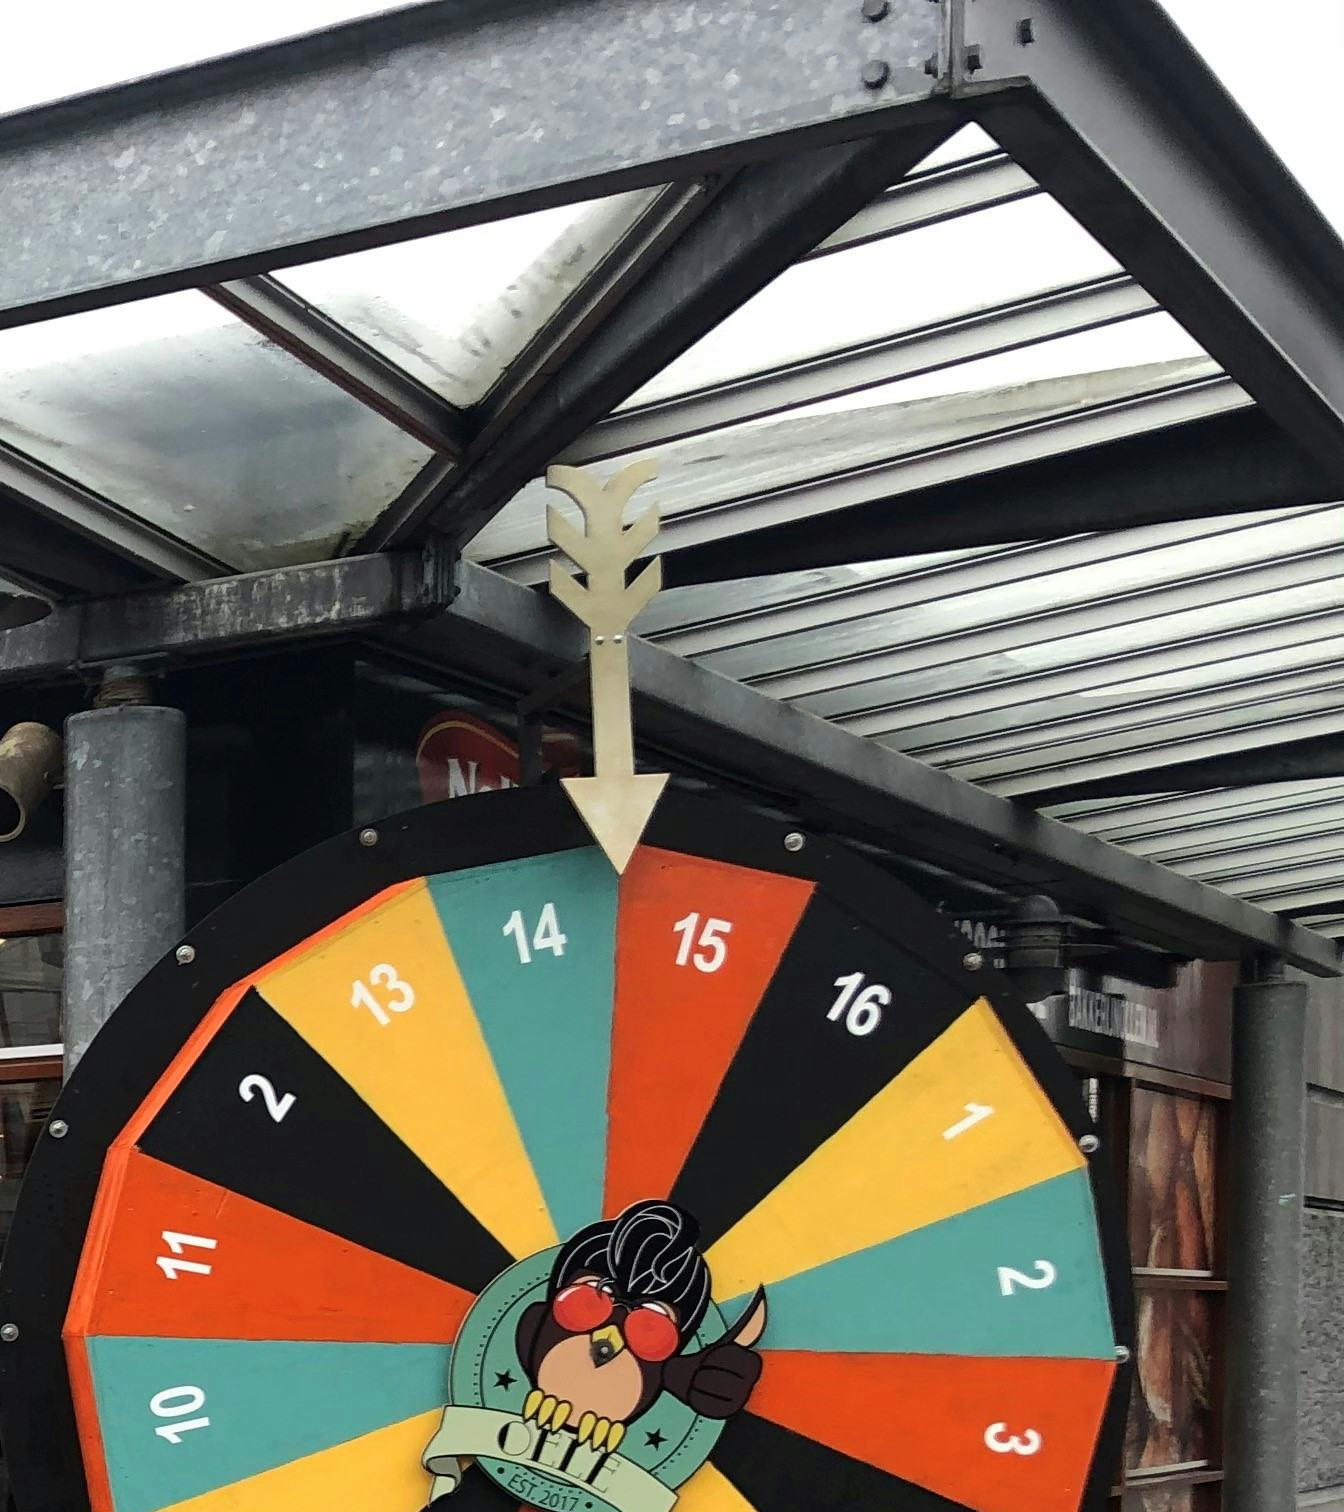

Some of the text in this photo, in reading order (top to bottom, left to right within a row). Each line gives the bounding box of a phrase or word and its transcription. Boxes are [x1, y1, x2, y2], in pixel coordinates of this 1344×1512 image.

[502, 902, 568, 964] 14
[673, 912, 731, 972] 15
[352, 964, 415, 1025] 13
[825, 972, 890, 1037] 16
[239, 1074, 297, 1122] 2
[941, 1102, 995, 1140] 1
[157, 1231, 217, 1280] 11
[996, 1258, 1058, 1297] 2
[149, 1385, 211, 1446] 10
[985, 1422, 1040, 1456] 3
[507, 1474, 580, 1512] EST. 2017
